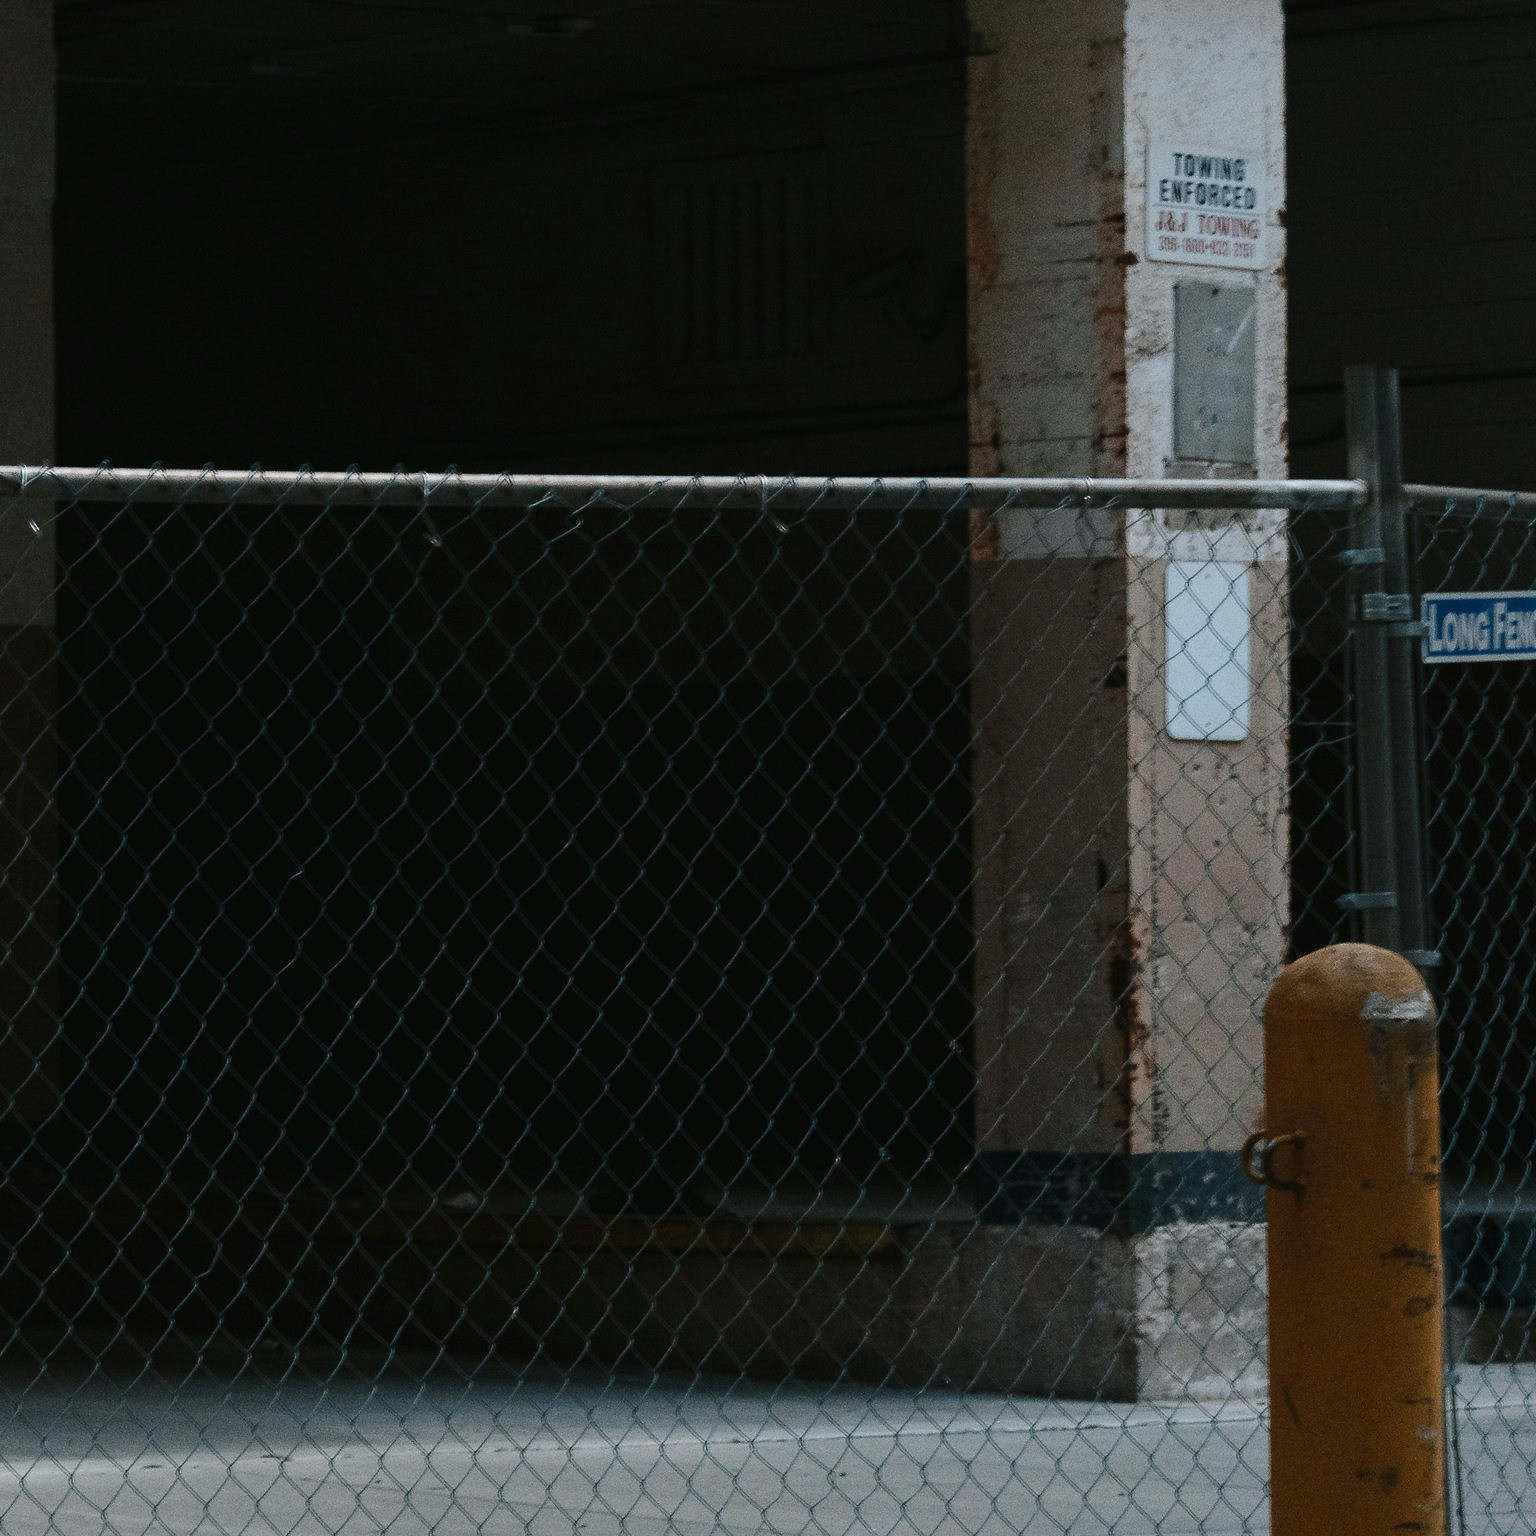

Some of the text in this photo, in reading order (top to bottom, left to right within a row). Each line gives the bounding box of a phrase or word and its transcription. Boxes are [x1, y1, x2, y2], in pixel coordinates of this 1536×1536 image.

[1173, 152, 1246, 182] TOWING
[1159, 178, 1256, 210] ENFORCED
[1197, 214, 1259, 240] TOWING
[1429, 601, 1536, 653] LONG FEN
